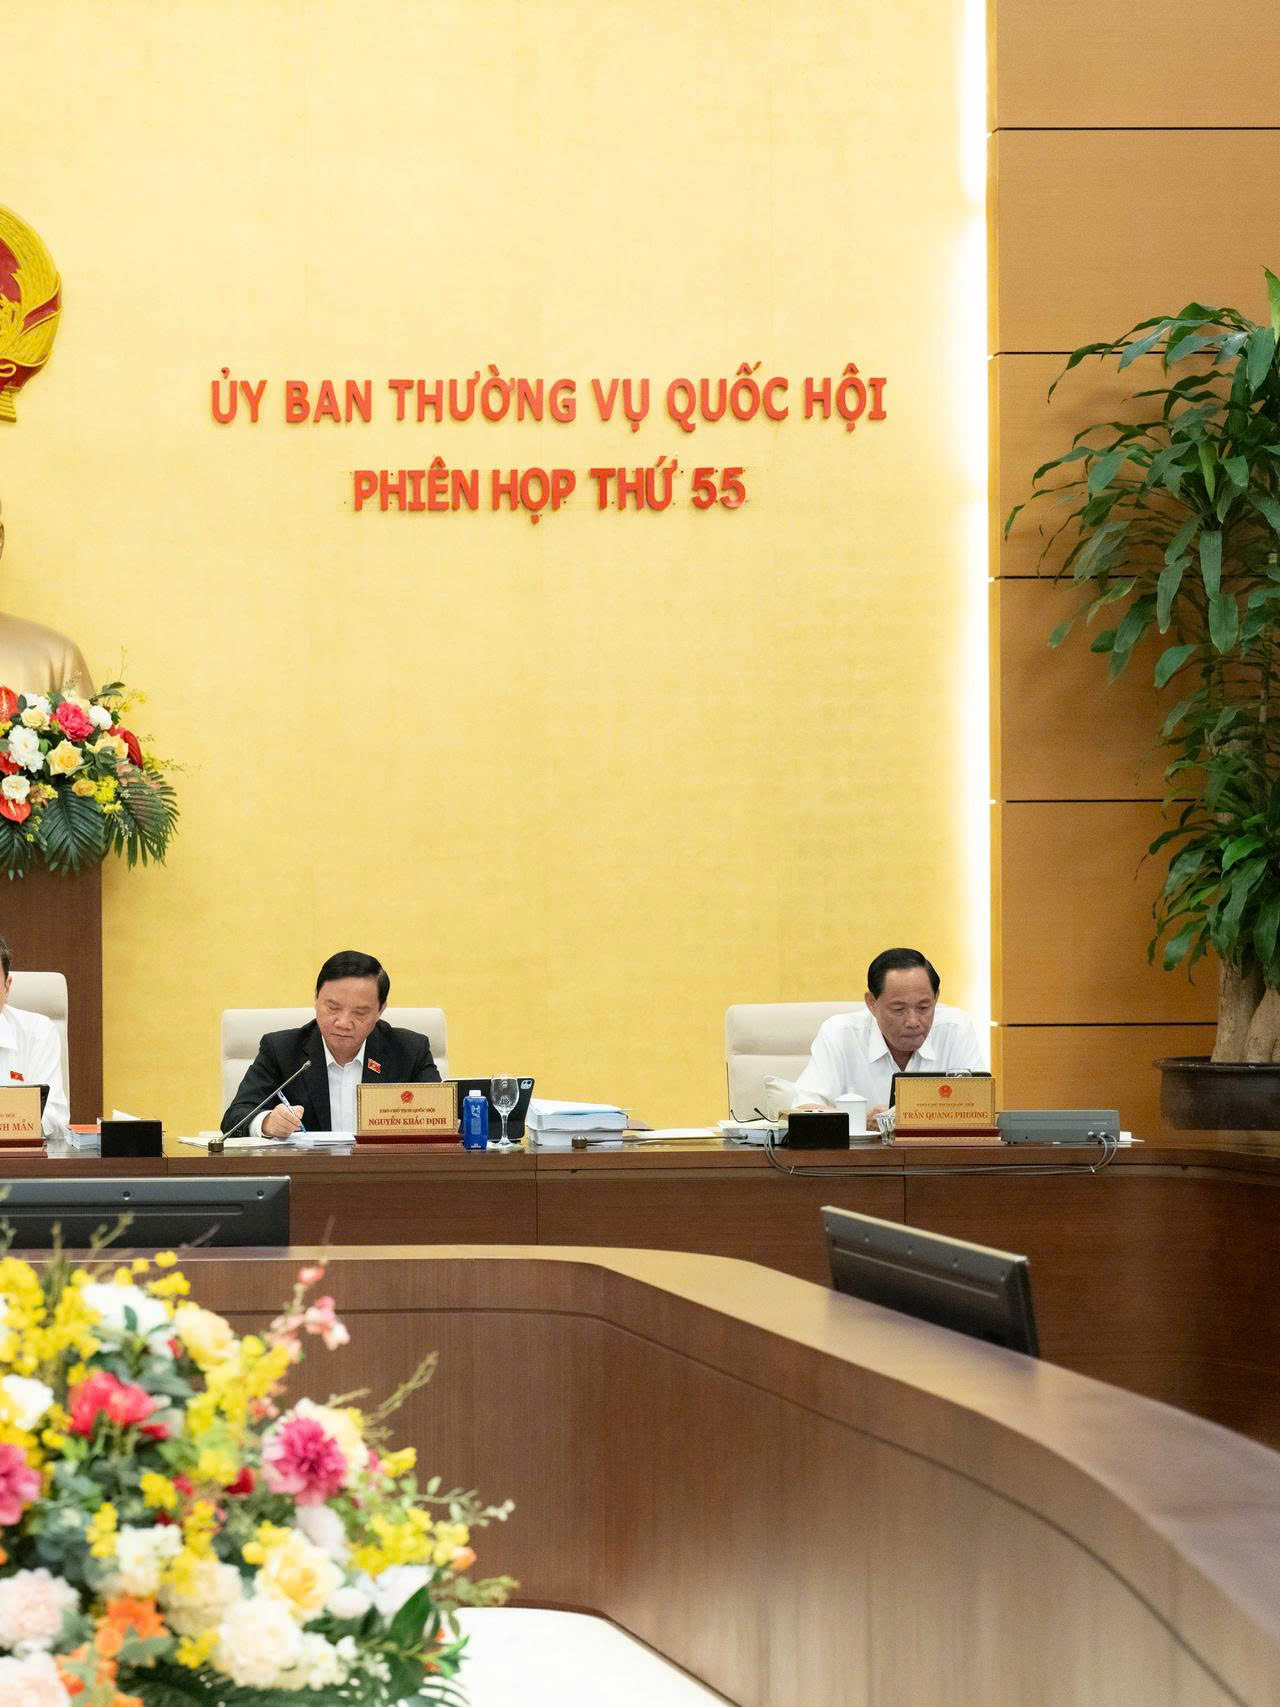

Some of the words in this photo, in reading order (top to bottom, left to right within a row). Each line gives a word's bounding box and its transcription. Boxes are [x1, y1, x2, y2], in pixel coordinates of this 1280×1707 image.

[211, 367, 265, 422] ỦY
[285, 379, 372, 423] BAN
[388, 364, 576, 422] THƯỜNG
[592, 378, 650, 431] VỤ
[666, 362, 789, 432] QUỐC
[804, 363, 887, 431] HỘI
[354, 456, 479, 512] PHIÊN
[491, 467, 576, 523] HỌP
[590, 455, 677, 510] THỨ
[691, 466, 746, 509] 55
[926, 1111, 953, 1120] QUANG
